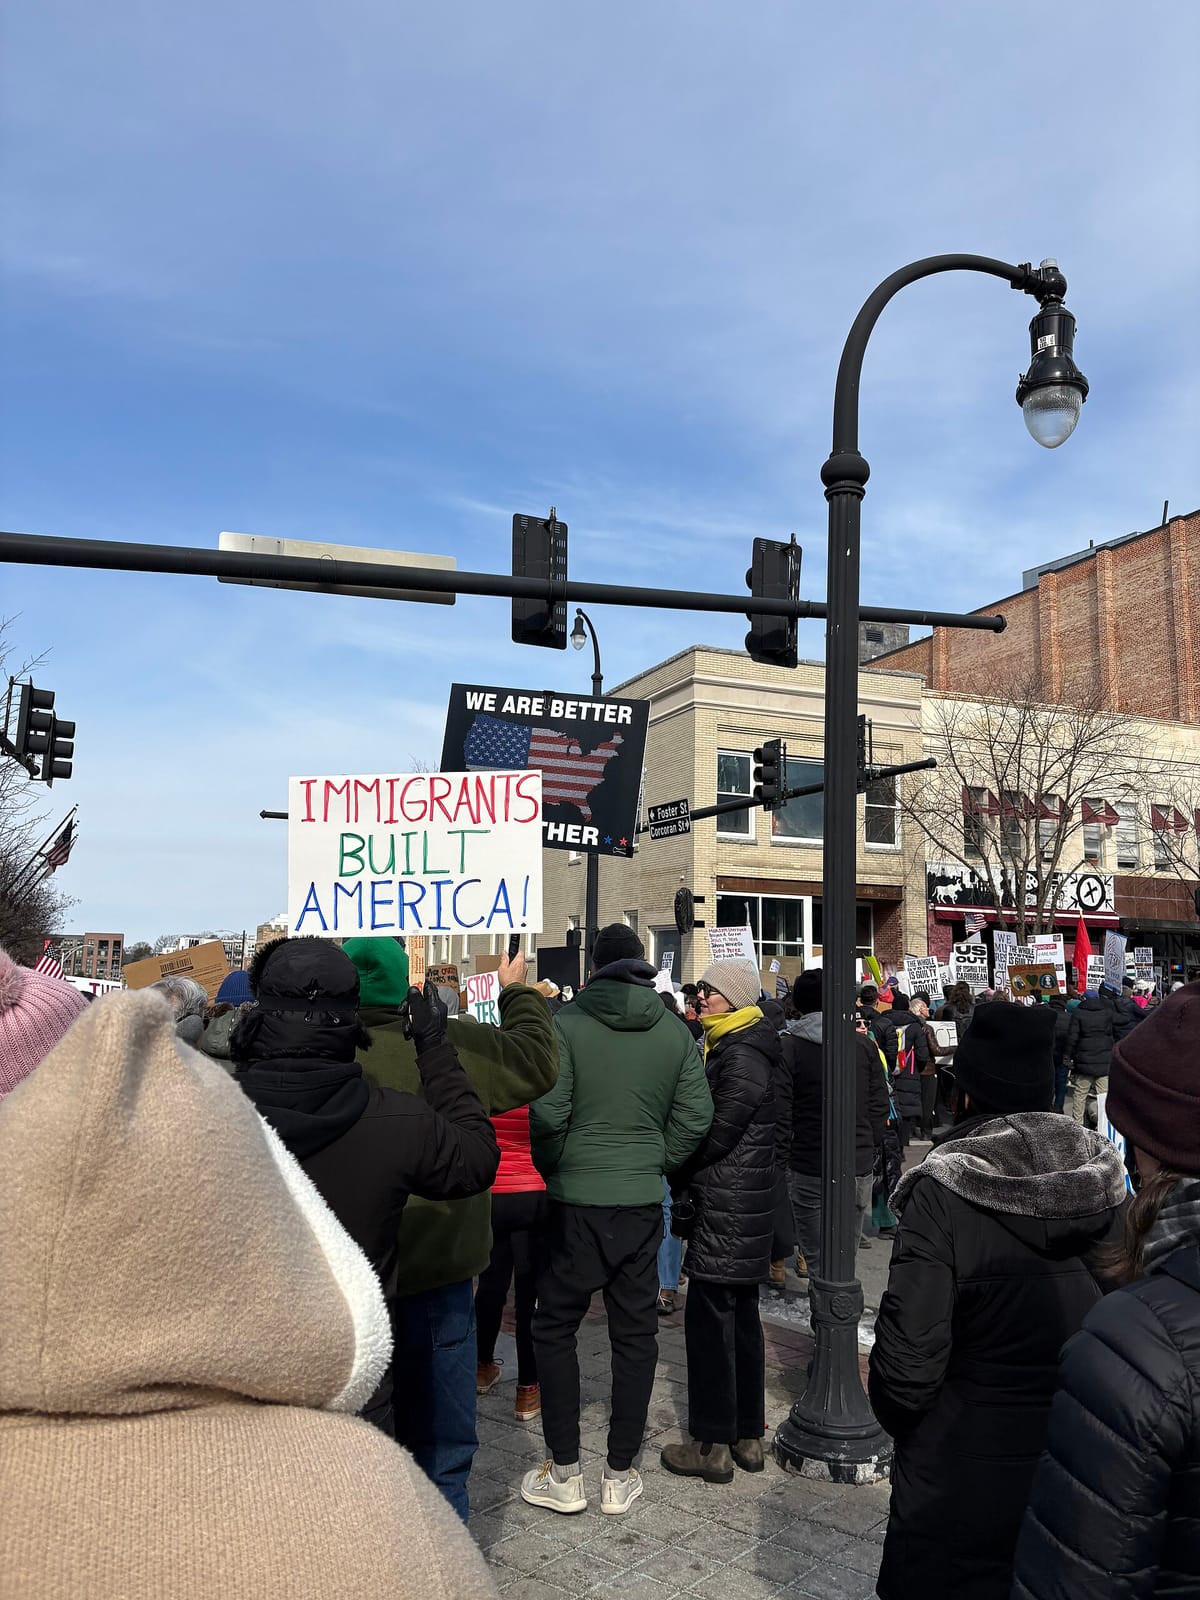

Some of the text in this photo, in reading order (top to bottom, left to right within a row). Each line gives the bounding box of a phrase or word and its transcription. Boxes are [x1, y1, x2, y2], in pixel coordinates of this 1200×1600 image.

[466, 691, 633, 724] WE ARE BETTER
[300, 774, 540, 824] IMMIGRANTS
[657, 801, 688, 819] Foster St
[650, 820, 685, 838] Corcoran St
[338, 830, 491, 877] BUILT
[295, 875, 530, 931] AMERICA!
[997, 933, 1011, 944] WE
[956, 945, 986, 956] US
[917, 957, 935, 966] WHOLE
[956, 956, 987, 964] OUT
[1009, 957, 1014, 965] IS
[909, 971, 915, 980] IS
[916, 969, 937, 979] GUILTY
[957, 973, 987, 981] CARIBBEAN
[467, 973, 495, 1004] STOP
[913, 984, 938, 994] DOWN!
